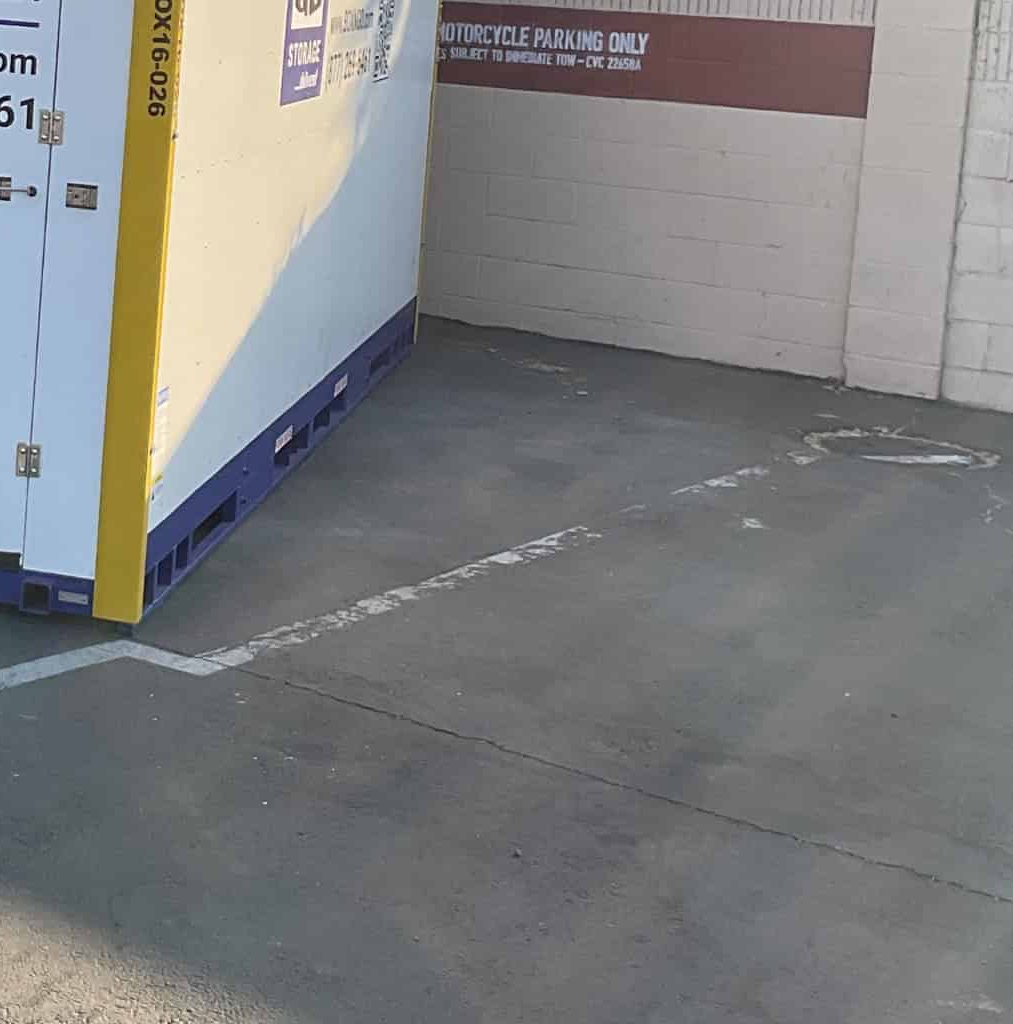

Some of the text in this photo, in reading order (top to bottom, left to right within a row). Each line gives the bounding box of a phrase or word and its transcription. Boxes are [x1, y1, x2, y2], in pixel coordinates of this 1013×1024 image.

[288, 38, 323, 69] STORAGE
[533, 27, 604, 52] PARKING
[608, 31, 650, 55] ONLY
